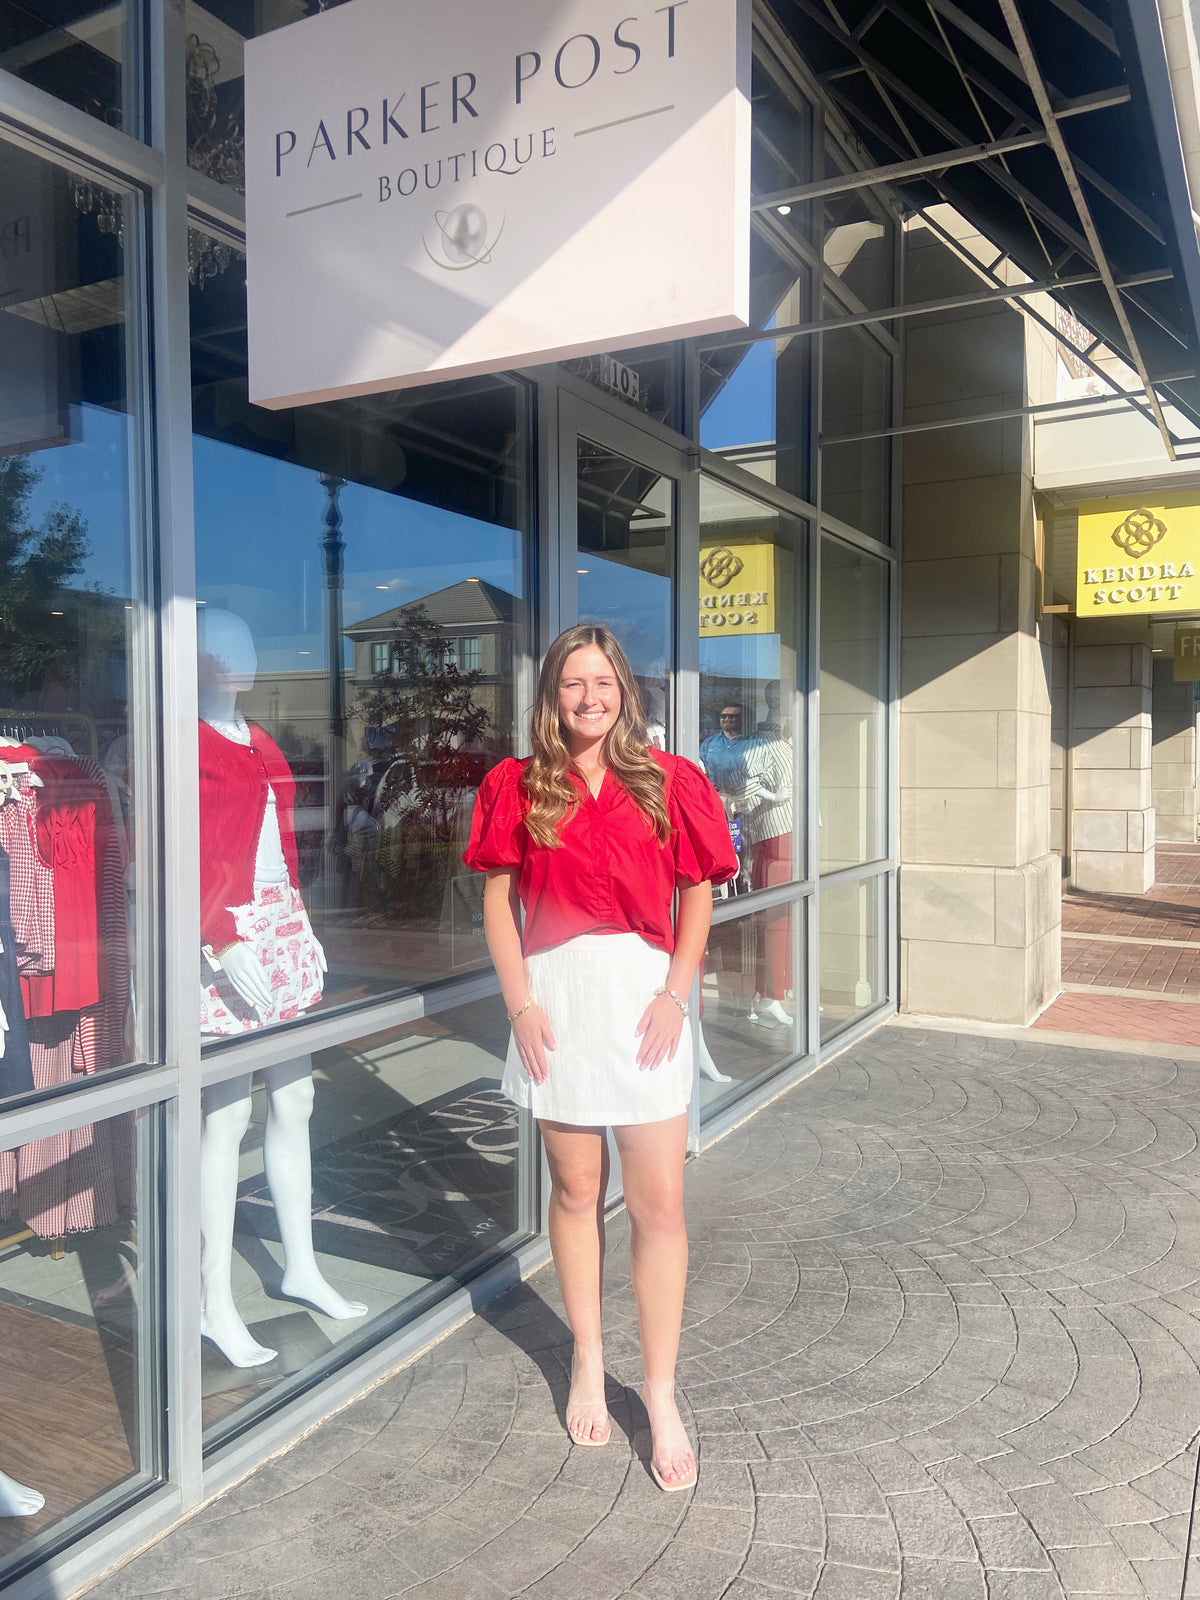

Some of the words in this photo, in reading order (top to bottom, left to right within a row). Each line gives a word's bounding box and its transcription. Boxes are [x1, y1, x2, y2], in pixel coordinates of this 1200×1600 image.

[275, 72, 479, 177] PARKER
[515, 0, 688, 104] POST
[378, 127, 557, 203] BOUTIQUE
[1084, 561, 1195, 584] KENDRA
[1093, 583, 1183, 605] SCOTT
